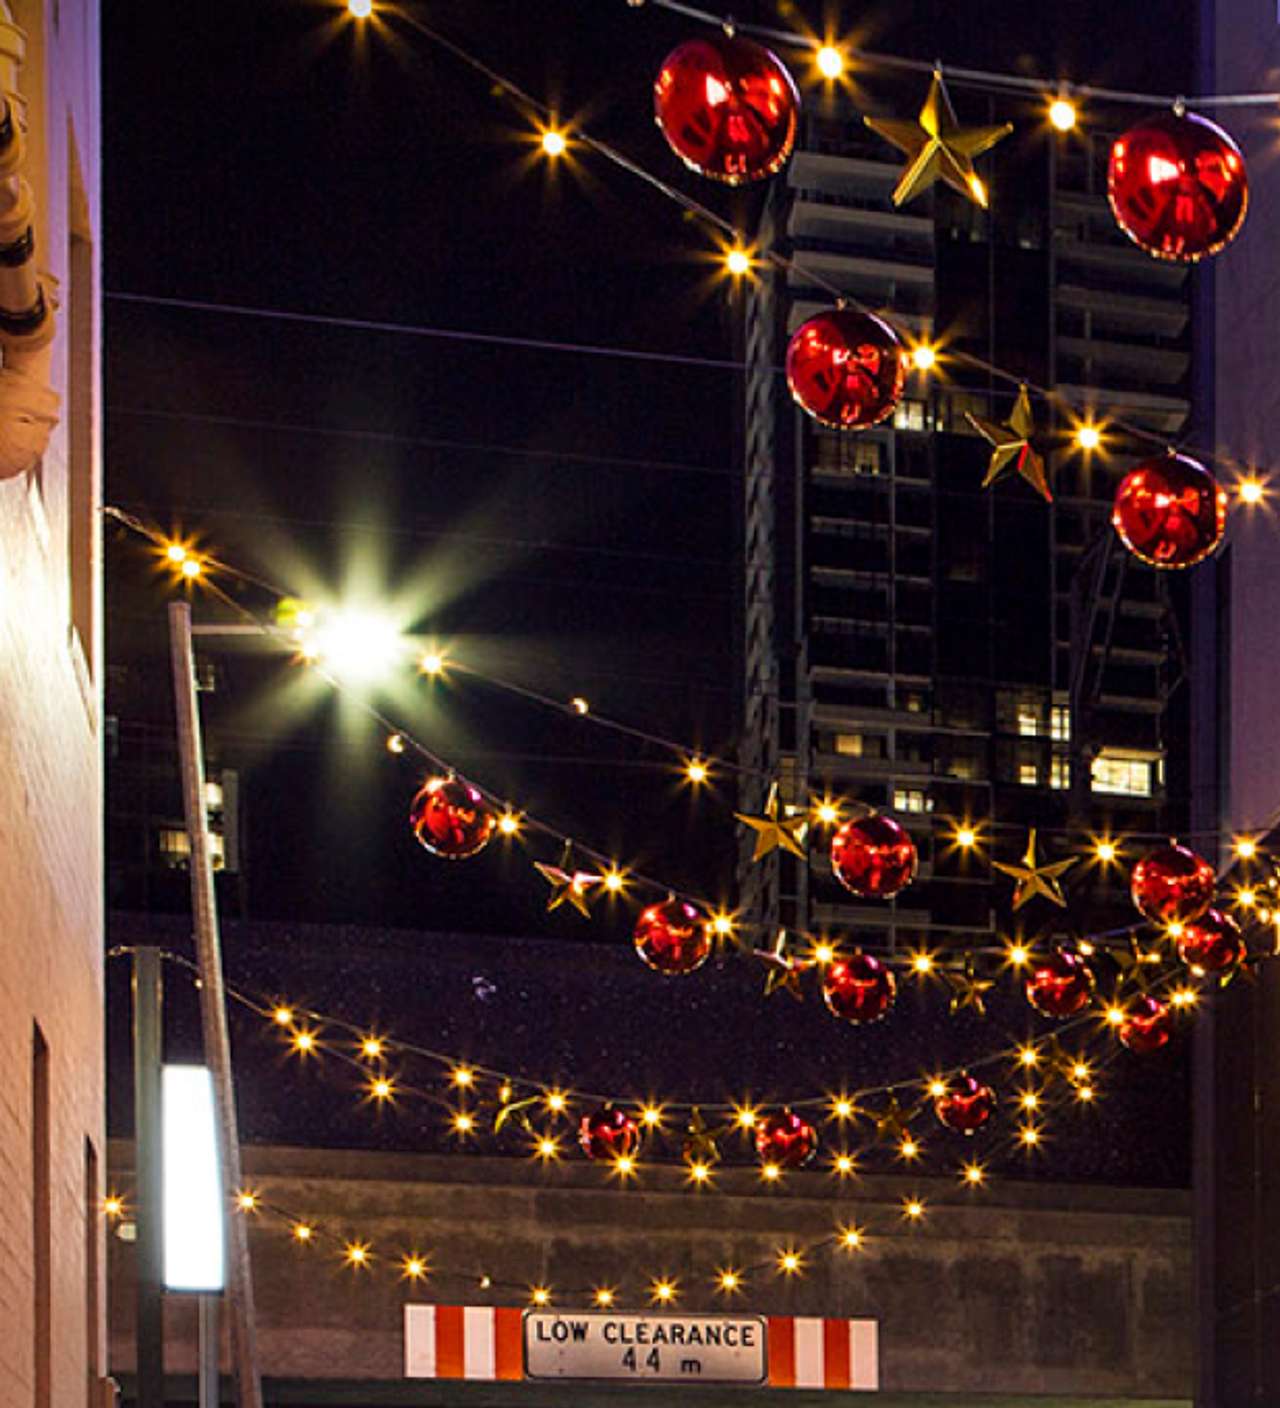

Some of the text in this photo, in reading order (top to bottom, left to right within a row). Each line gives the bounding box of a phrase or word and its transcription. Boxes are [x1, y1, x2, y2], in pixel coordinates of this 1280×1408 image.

[537, 1321, 754, 1346] LOW CLEARANCE
[680, 1359, 702, 1374] m
